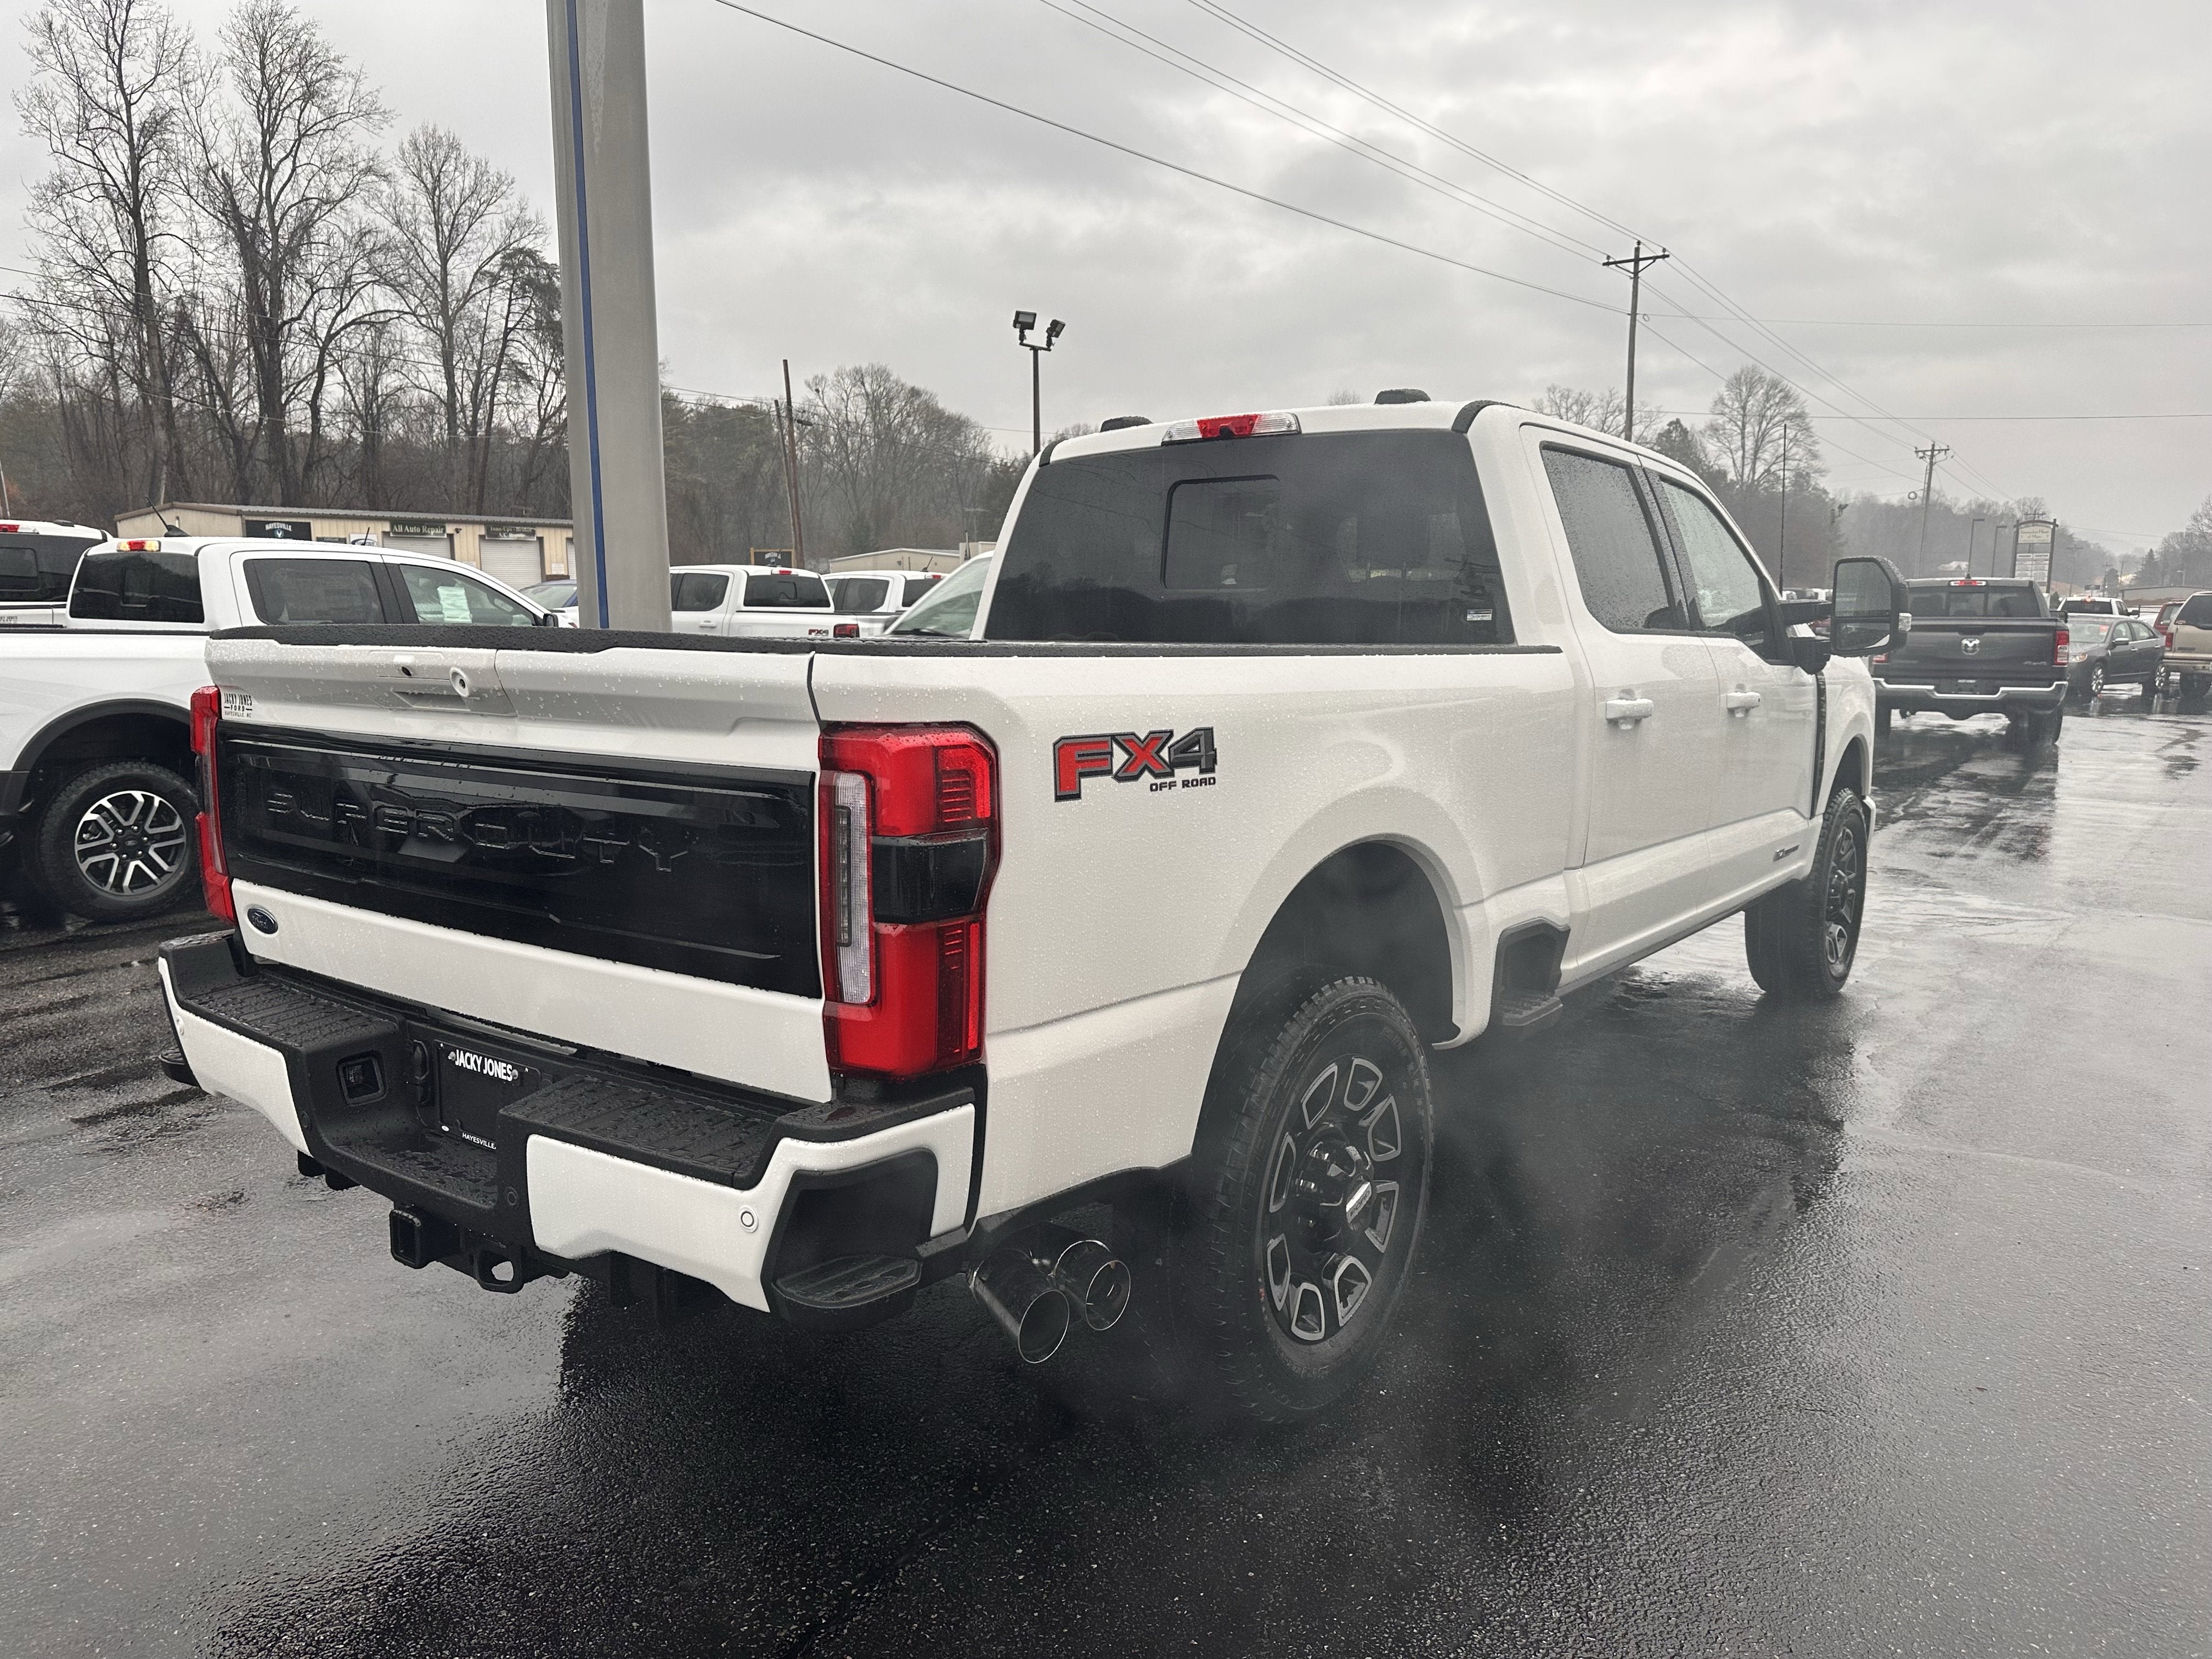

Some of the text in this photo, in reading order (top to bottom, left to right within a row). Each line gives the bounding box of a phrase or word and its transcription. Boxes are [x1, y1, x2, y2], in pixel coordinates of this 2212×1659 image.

[422, 526, 444, 535] Repair
[224, 693, 252, 706] JACKY JONES
[1053, 727, 1217, 803] FX4
[1149, 776, 1216, 792] OFF ROAD
[267, 789, 696, 872] SUPER DUTY
[455, 1049, 513, 1081] JACKY JONES
[1350, 1190, 1370, 1216] FORD
